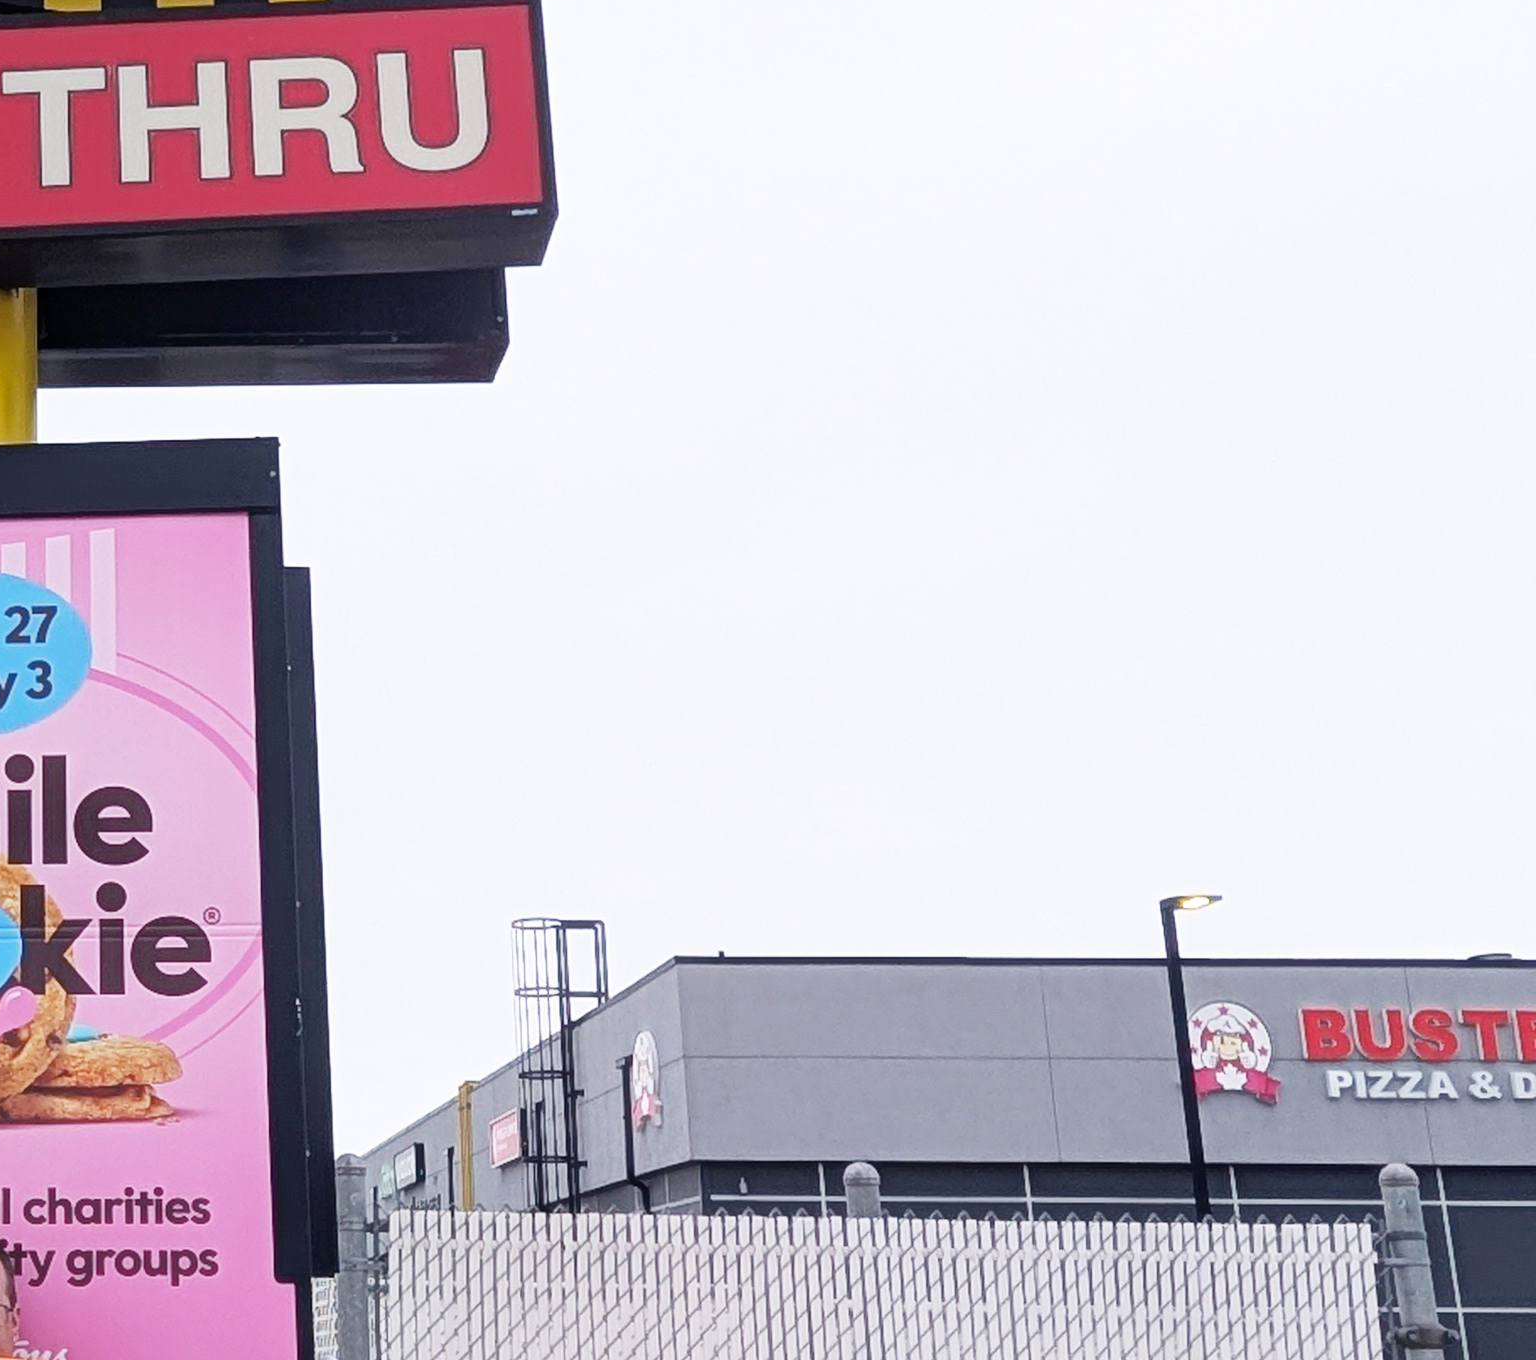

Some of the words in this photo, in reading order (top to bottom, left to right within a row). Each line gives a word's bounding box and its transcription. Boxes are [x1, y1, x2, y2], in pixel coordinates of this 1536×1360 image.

[2, 48, 490, 188] THRU
[4, 605, 58, 644] 27
[25, 660, 53, 700] 3
[1325, 1068, 1459, 1100] PIZZA
[1468, 1070, 1503, 1099] &
[23, 1186, 211, 1226] charities
[66, 1249, 219, 1287] groups
